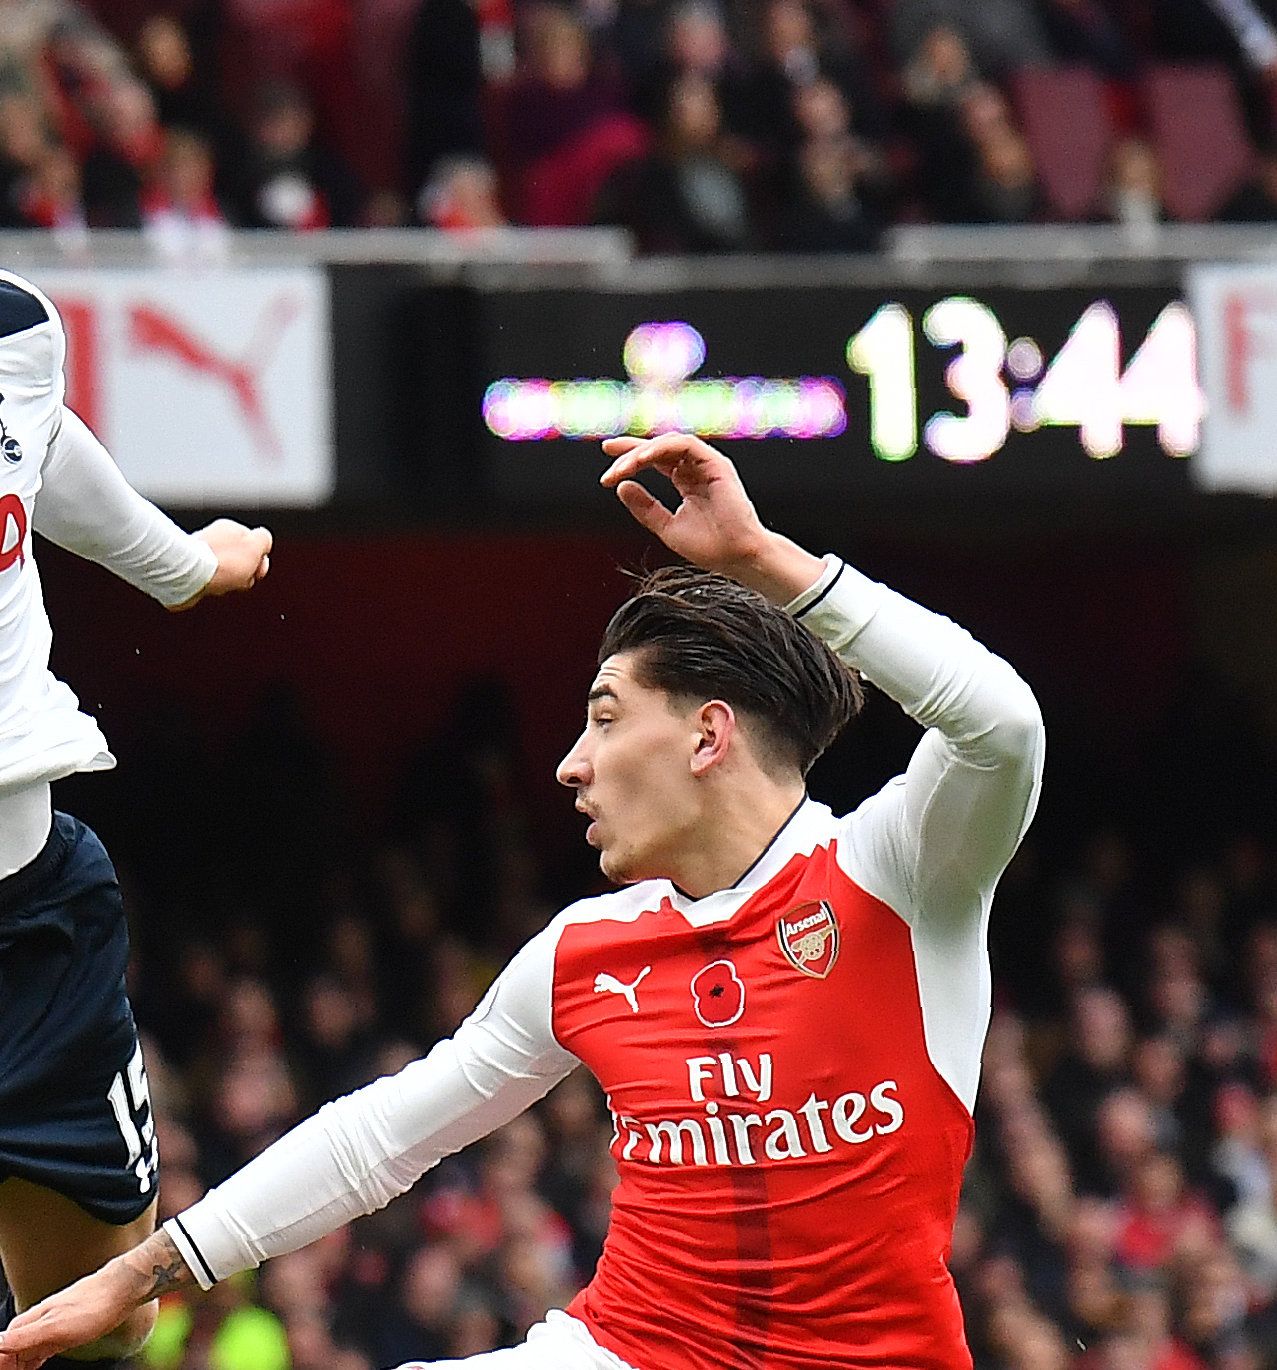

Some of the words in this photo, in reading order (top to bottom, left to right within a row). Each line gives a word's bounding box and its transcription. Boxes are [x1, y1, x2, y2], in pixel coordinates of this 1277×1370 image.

[847, 294, 1205, 462] 13:44
[786, 908, 828, 938] Arsenal
[685, 1052, 773, 1104] Fly
[609, 1080, 904, 1166] Emirates
